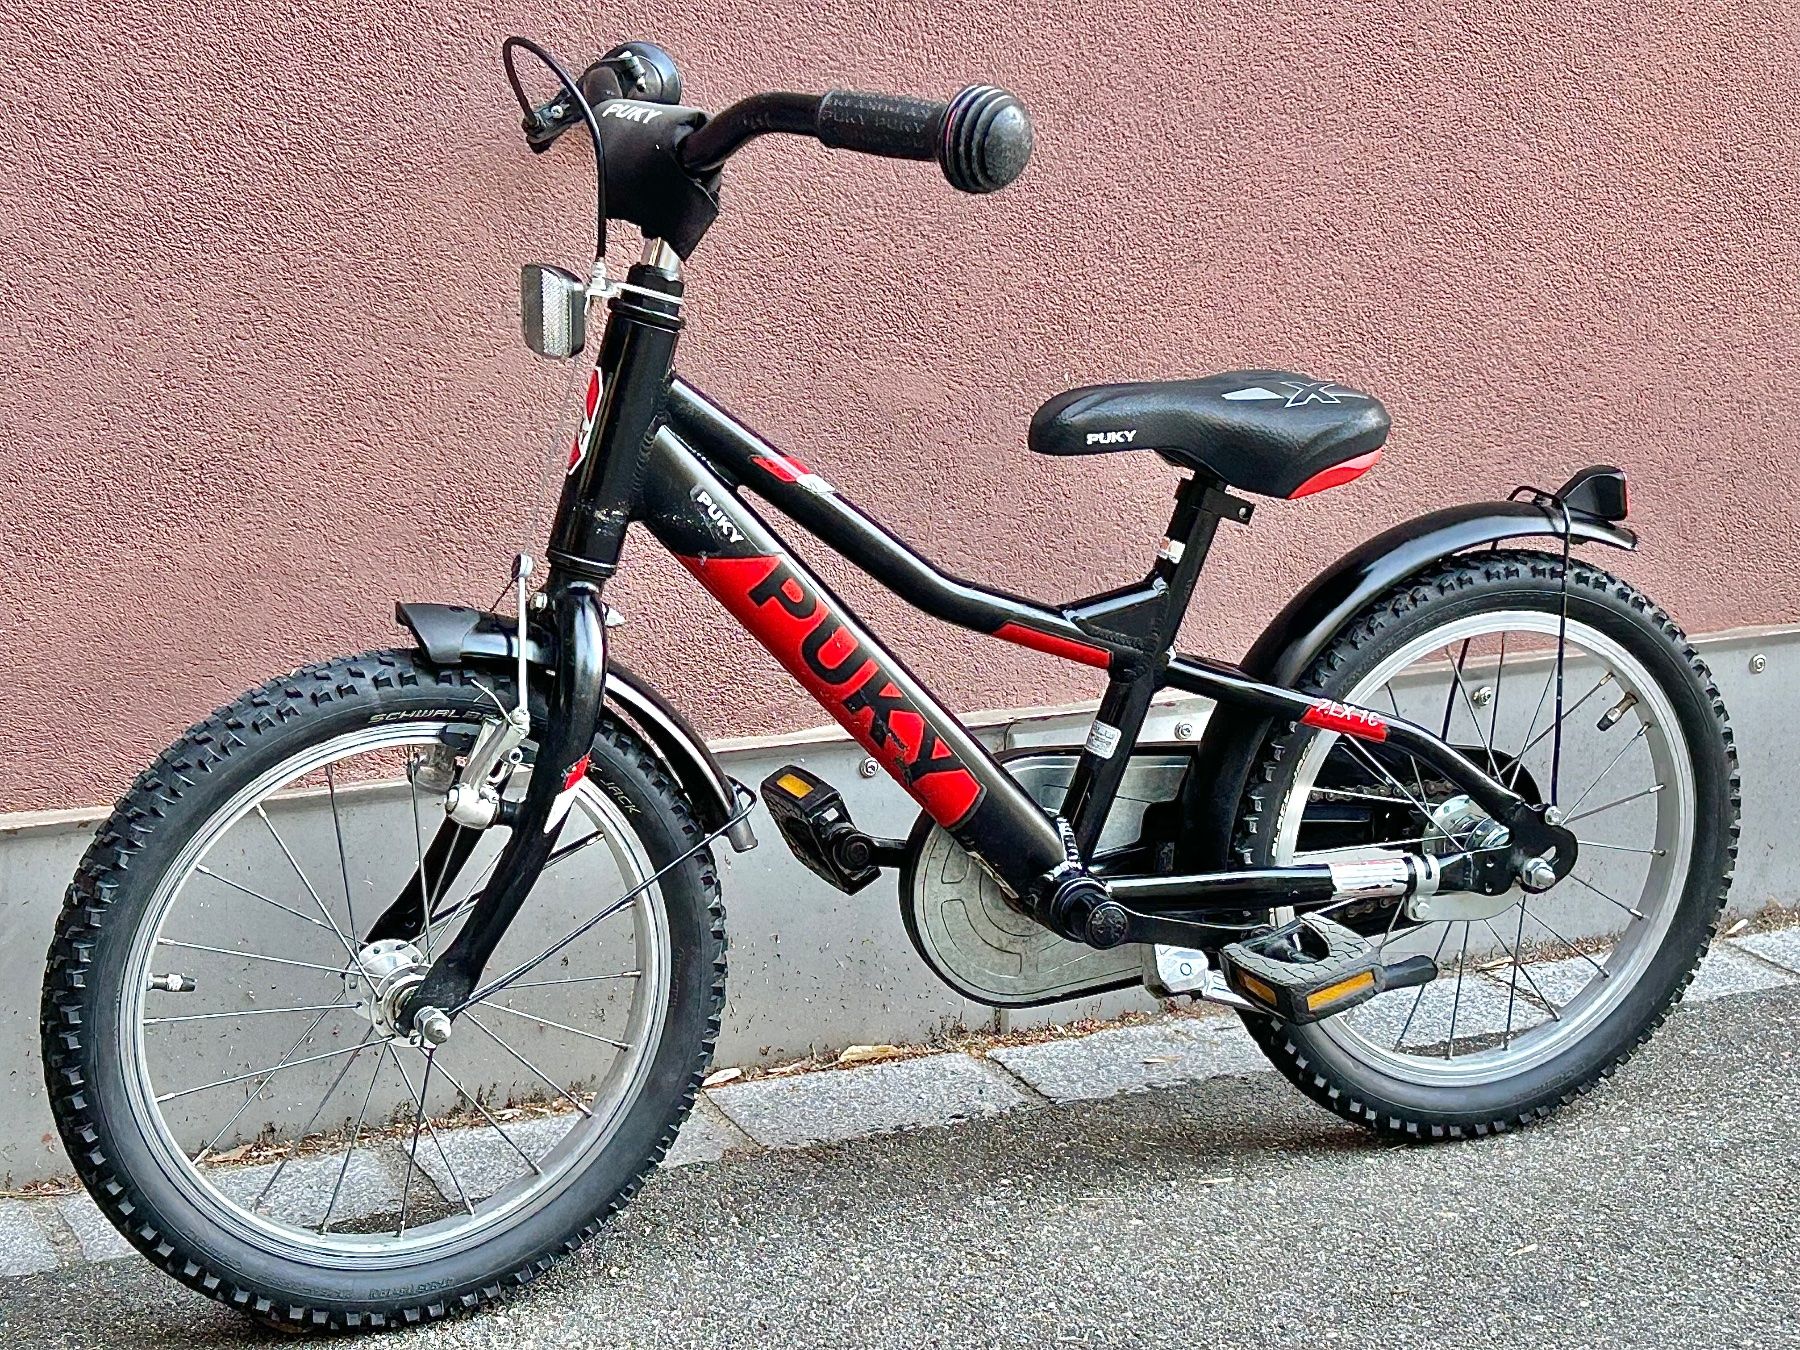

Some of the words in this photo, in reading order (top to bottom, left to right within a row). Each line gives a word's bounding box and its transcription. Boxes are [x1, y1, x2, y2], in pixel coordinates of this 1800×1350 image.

[602, 103, 662, 124] PUKY
[1086, 430, 1137, 445] PUKY
[695, 491, 745, 544] PUKY
[748, 562, 970, 787] PUKY
[600, 779, 642, 814] JACK
